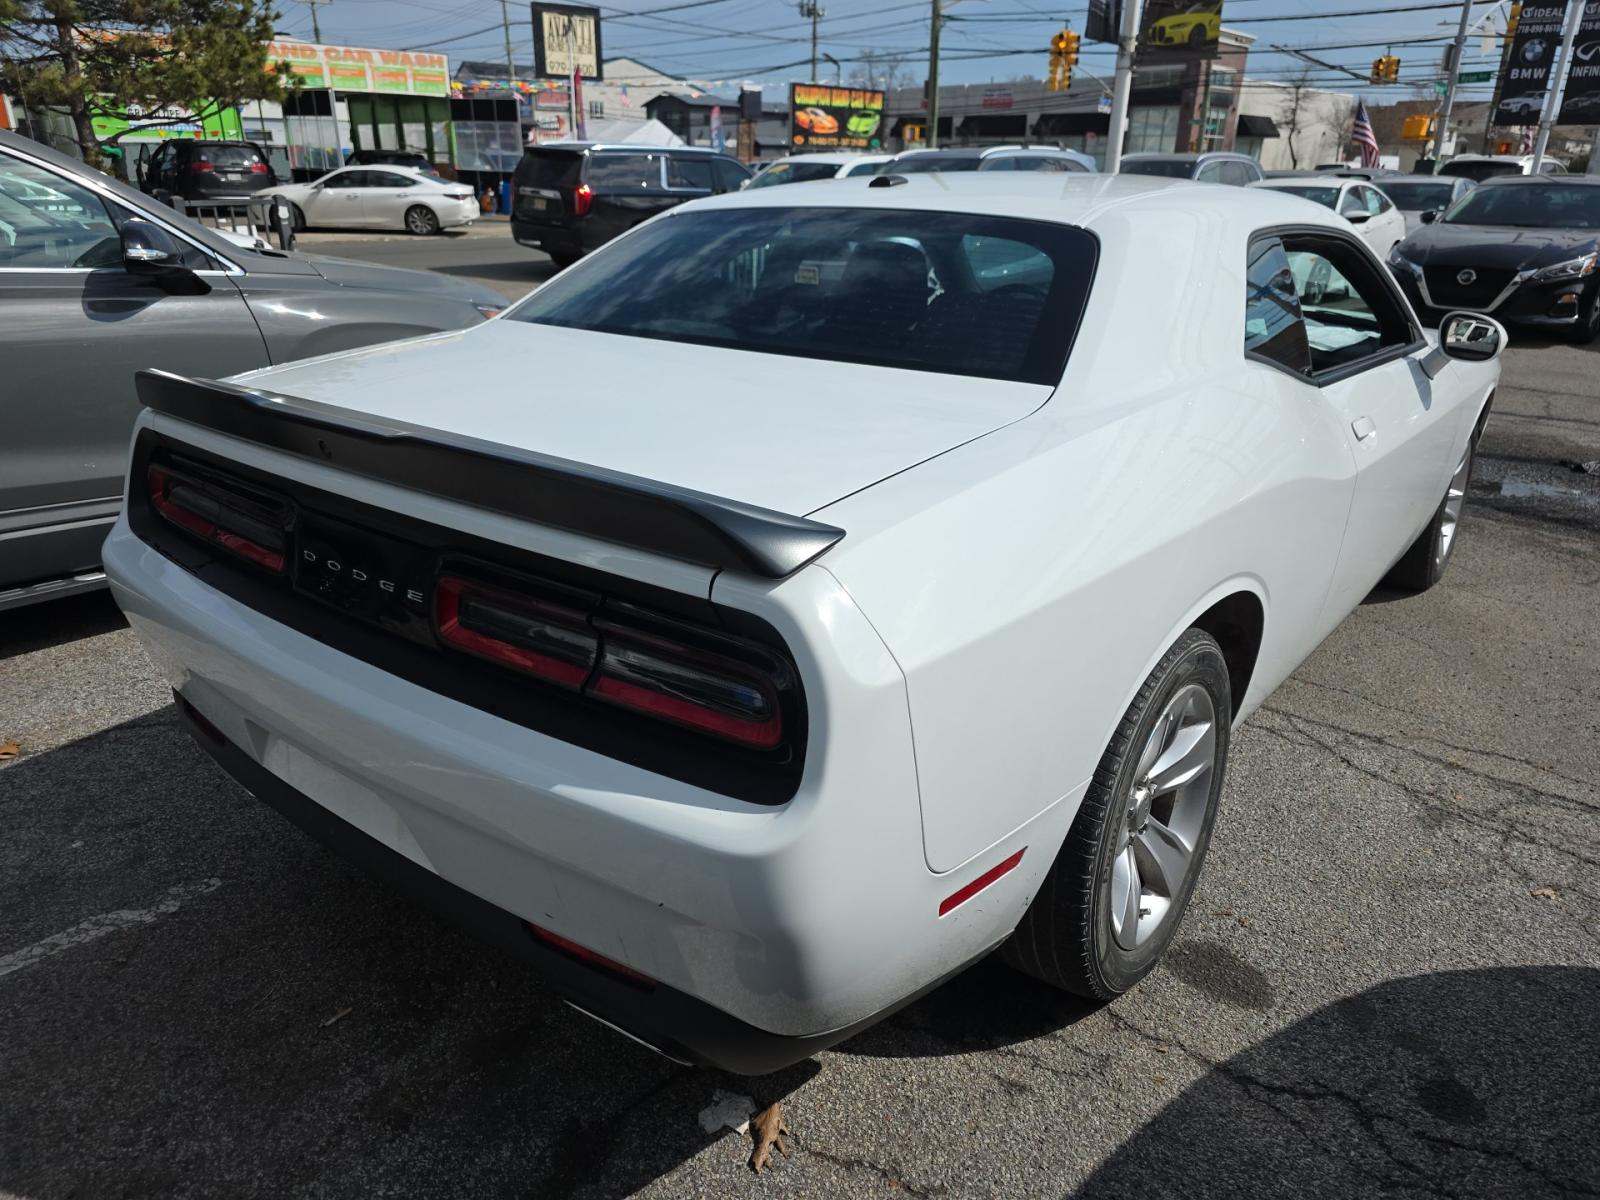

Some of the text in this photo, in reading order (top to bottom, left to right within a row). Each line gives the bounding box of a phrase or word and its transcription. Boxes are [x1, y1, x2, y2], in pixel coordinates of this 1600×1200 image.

[1533, 7, 1563, 18] IDEAL
[268, 43, 445, 69] AND CAR WASH
[1510, 68, 1546, 80] BMW
[303, 550, 424, 603] DODGE
